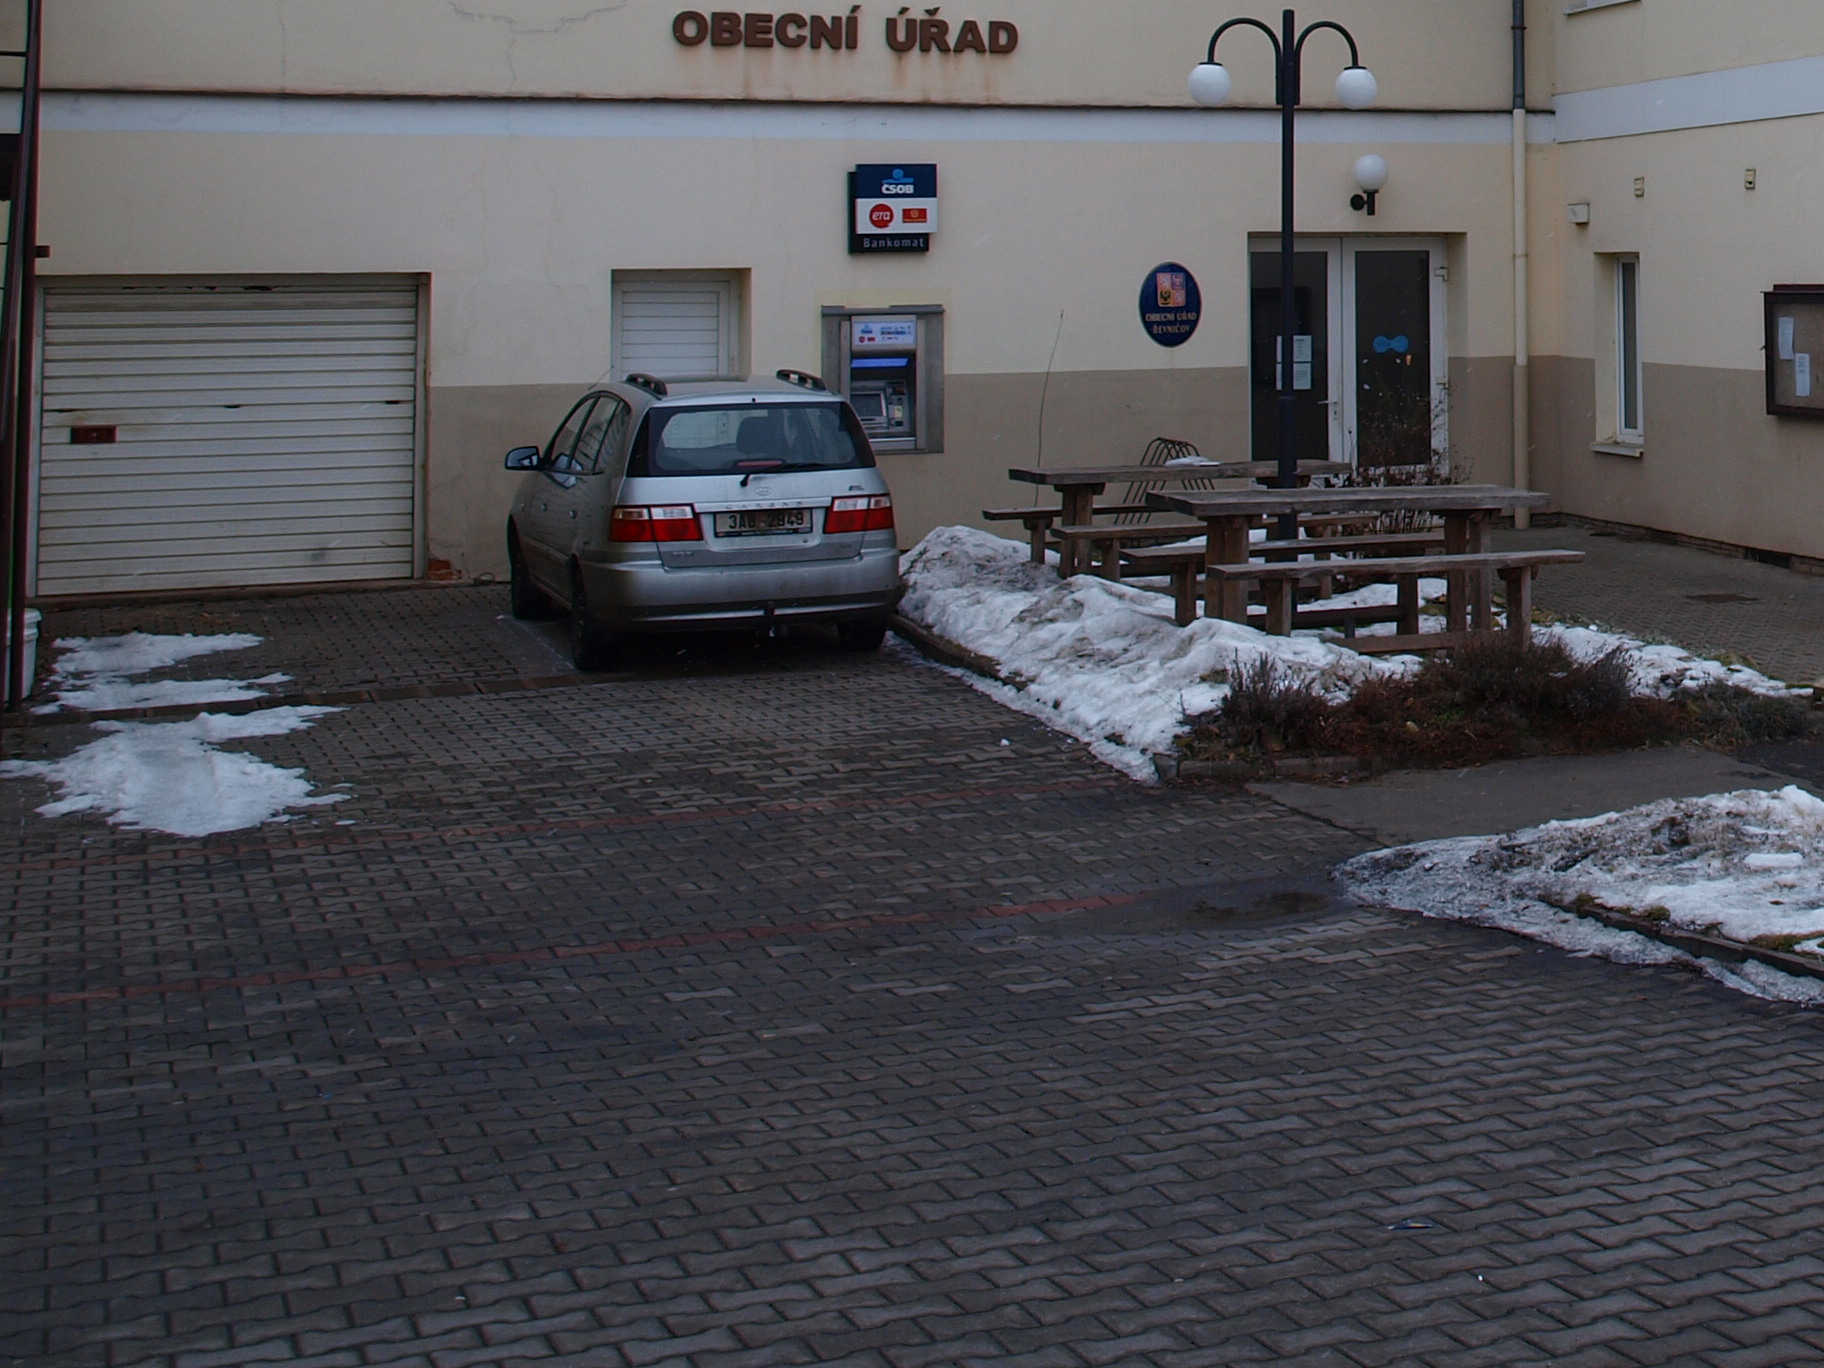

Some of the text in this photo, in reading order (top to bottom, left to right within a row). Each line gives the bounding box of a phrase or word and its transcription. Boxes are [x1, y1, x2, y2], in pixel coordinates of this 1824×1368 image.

[672, 4, 1019, 54] OBECNÍ ÚŘAD
[881, 183, 914, 194] ČSOB
[863, 237, 924, 248] Bankomat
